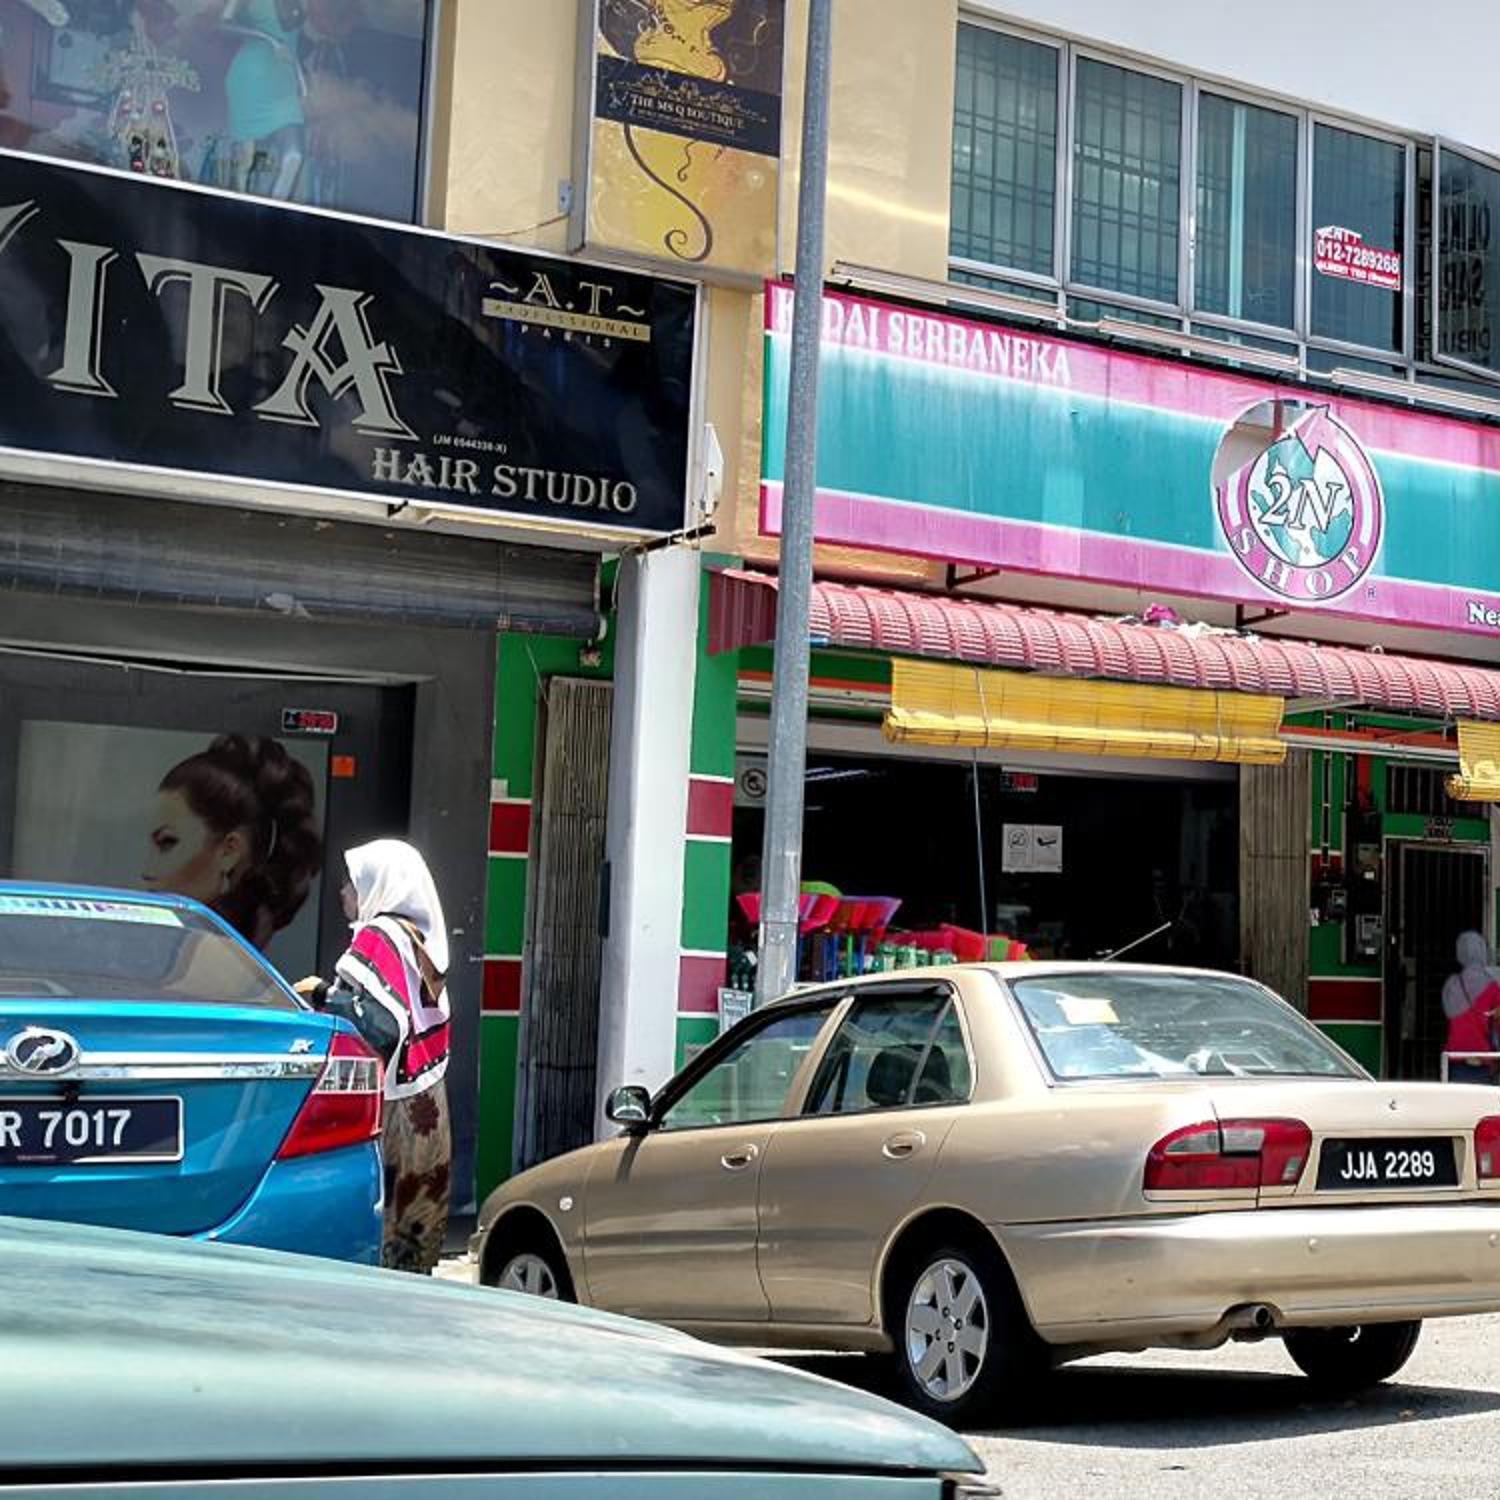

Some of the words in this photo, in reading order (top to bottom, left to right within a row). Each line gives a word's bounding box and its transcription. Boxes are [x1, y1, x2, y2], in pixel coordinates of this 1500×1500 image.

[776, 287, 879, 348] KDAI
[888, 310, 1072, 384] SERBANEKA
[371, 447, 481, 495] HAIR
[491, 464, 638, 513] STUDIO
[1258, 471, 1344, 534] 2N
[1232, 527, 1363, 596] SHOP
[38, 1109, 132, 1149] 7017
[1341, 1151, 1379, 1180] JJA
[1384, 1150, 1436, 1179] 2289
